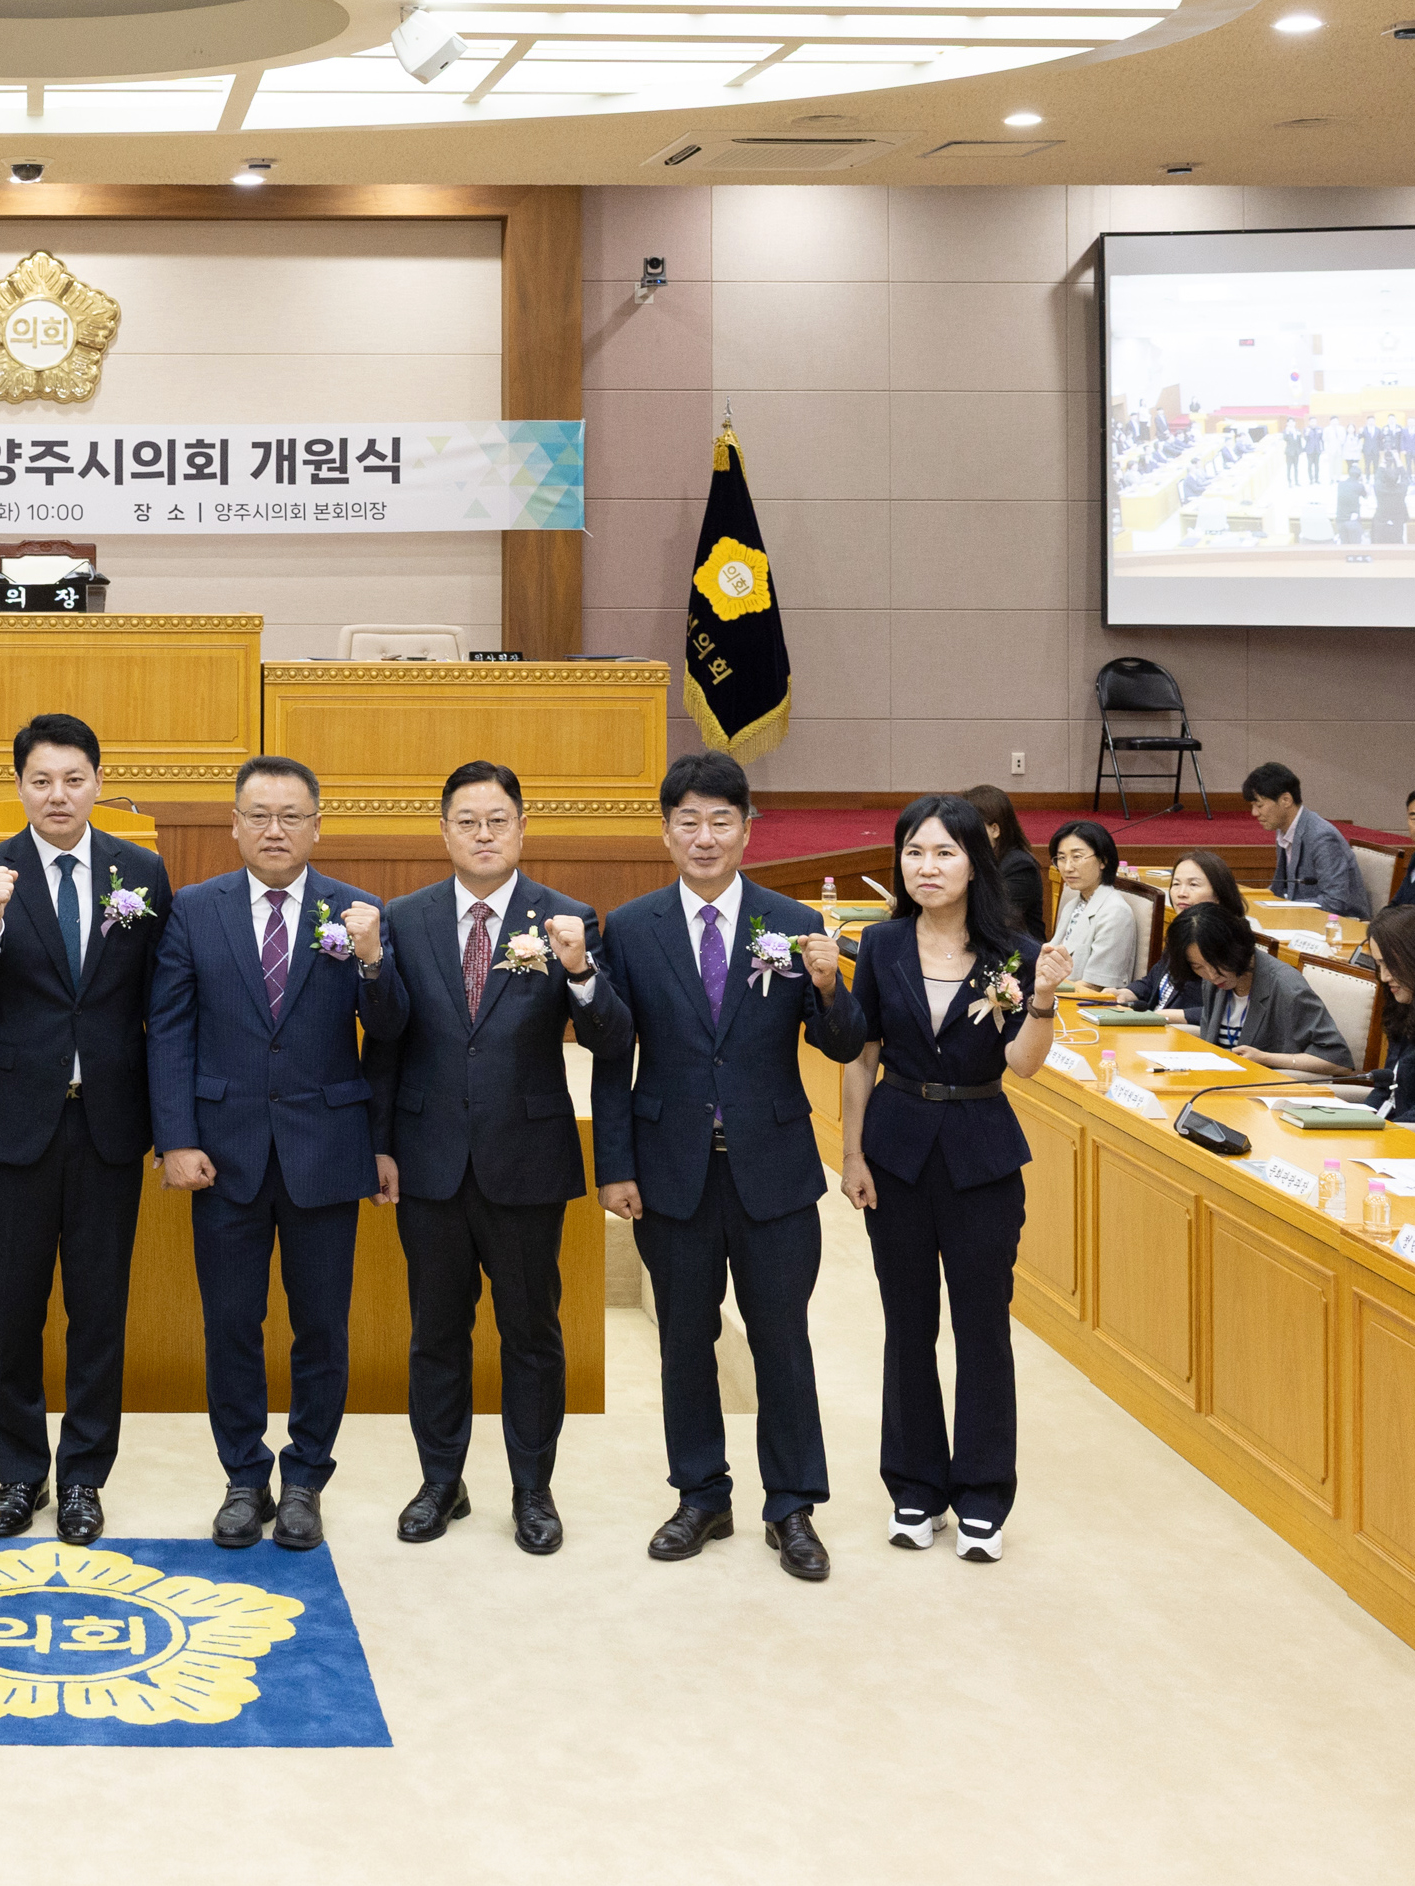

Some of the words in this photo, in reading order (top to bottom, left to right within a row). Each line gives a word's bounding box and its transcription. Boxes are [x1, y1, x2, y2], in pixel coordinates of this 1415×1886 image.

[10, 316, 68, 350] 의회
[250, 436, 401, 485] 개원식
[27, 503, 84, 521] 10:00
[214, 502, 306, 522] 양주시의회
[313, 501, 388, 522] 본회의장
[722, 565, 750, 595] 의회
